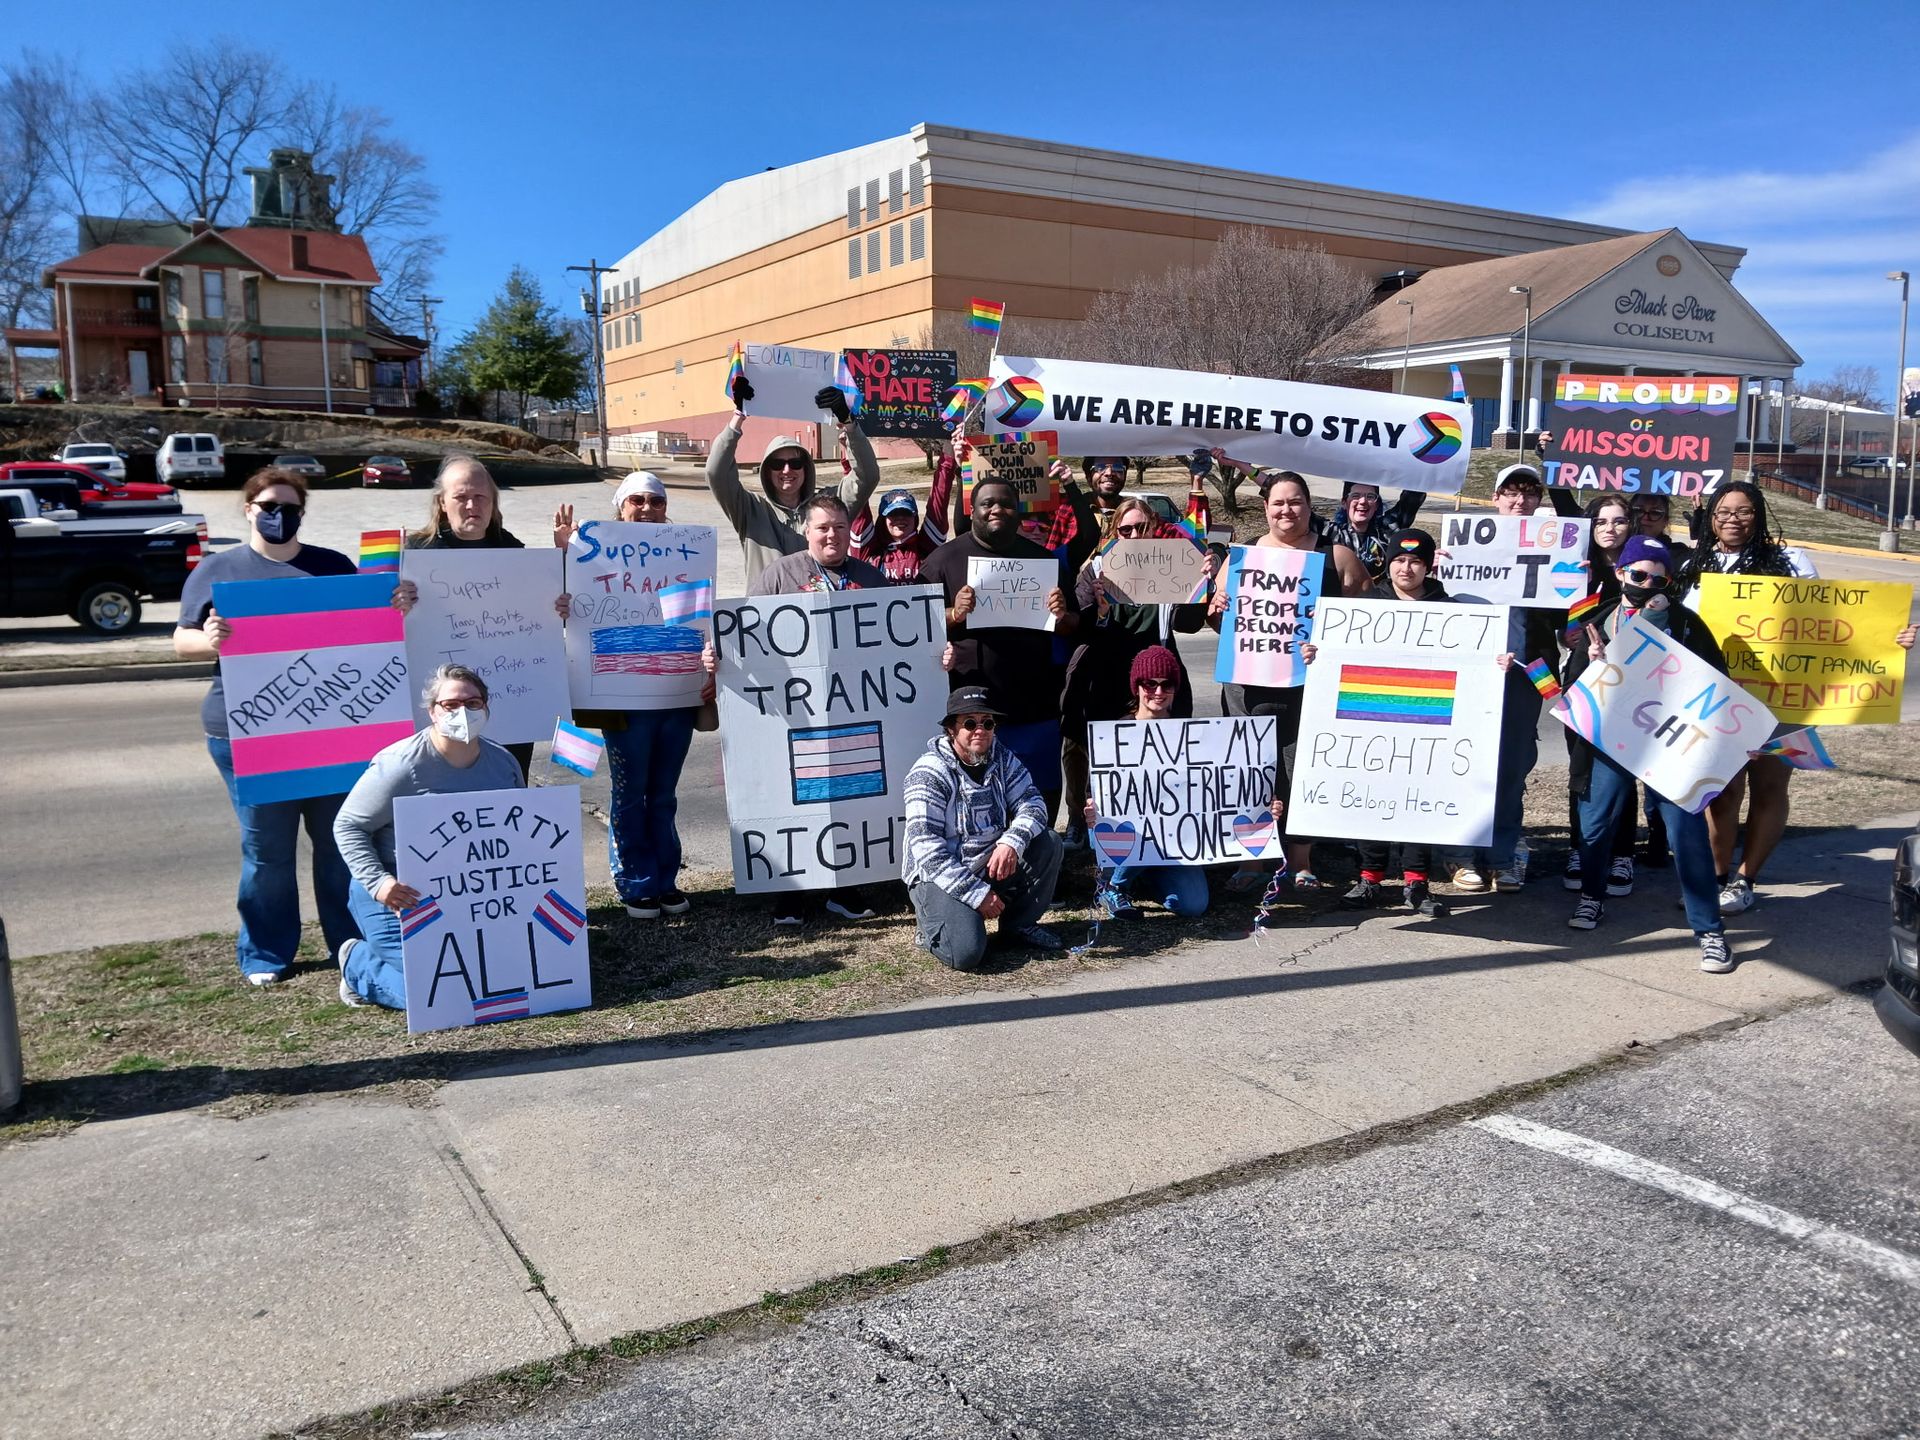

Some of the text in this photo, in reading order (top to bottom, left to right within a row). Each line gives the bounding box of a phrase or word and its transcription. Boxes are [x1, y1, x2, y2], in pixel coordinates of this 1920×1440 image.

[1672, 296, 1717, 322] River
[1614, 322, 1714, 344] COLISEUM
[747, 345, 831, 371] EQUALITY
[847, 352, 891, 378] NO
[864, 376, 933, 402] HATE
[1564, 381, 1731, 405] PROUD
[859, 403, 869, 415] N
[1052, 394, 1407, 449] WE ARE HERE TO STAY
[1630, 418, 1654, 432] OF
[978, 442, 1036, 456] IF WE GO
[1560, 427, 1710, 462] MISSOURI
[991, 456, 1024, 468] DOWN
[999, 468, 1015, 480] GO
[1016, 466, 1044, 479] DOWN
[1542, 461, 1724, 497] TRANS KIDZ
[576, 520, 700, 568] Support
[1447, 518, 1580, 549] NO LGB
[970, 559, 1024, 575] TRANS
[1110, 546, 1173, 576] Empathy
[430, 568, 501, 600] Support
[981, 577, 1041, 594] LIVES
[1147, 579, 1161, 594] a
[1170, 576, 1193, 593] Sin
[1235, 569, 1311, 597] TRANS
[1440, 554, 1551, 599] WITHOUT T
[1236, 596, 1315, 618] PEOPLE
[1731, 582, 1763, 599] IF
[1834, 587, 1869, 606] NOT
[593, 595, 659, 626] Righ
[713, 595, 944, 660] PROTECT
[1234, 617, 1310, 640] BELONG
[1321, 607, 1501, 650] PROTECT
[1731, 615, 1854, 643] SCARED
[1240, 638, 1298, 654] HERE
[1771, 653, 1816, 673] NOT
[1822, 657, 1886, 677] PAYING
[229, 653, 317, 735] PROTECT
[285, 663, 362, 725] TRANS
[340, 656, 407, 724] RIGHTS
[744, 661, 916, 716] TRANS
[1732, 679, 1897, 708] TTENTION
[1089, 718, 1274, 768] LEAVE MY
[1311, 732, 1473, 776] RIGHTS
[1091, 765, 1276, 817] TRANS FRIENDS
[1302, 780, 1459, 820] We Belong Here
[408, 805, 569, 863] LIBERTY
[742, 816, 906, 880] RIGH
[1139, 811, 1242, 861] ALONE
[466, 838, 510, 862] AND
[429, 861, 558, 900] JUSTICE
[470, 896, 518, 922] FOR
[427, 922, 573, 1008] ALL
